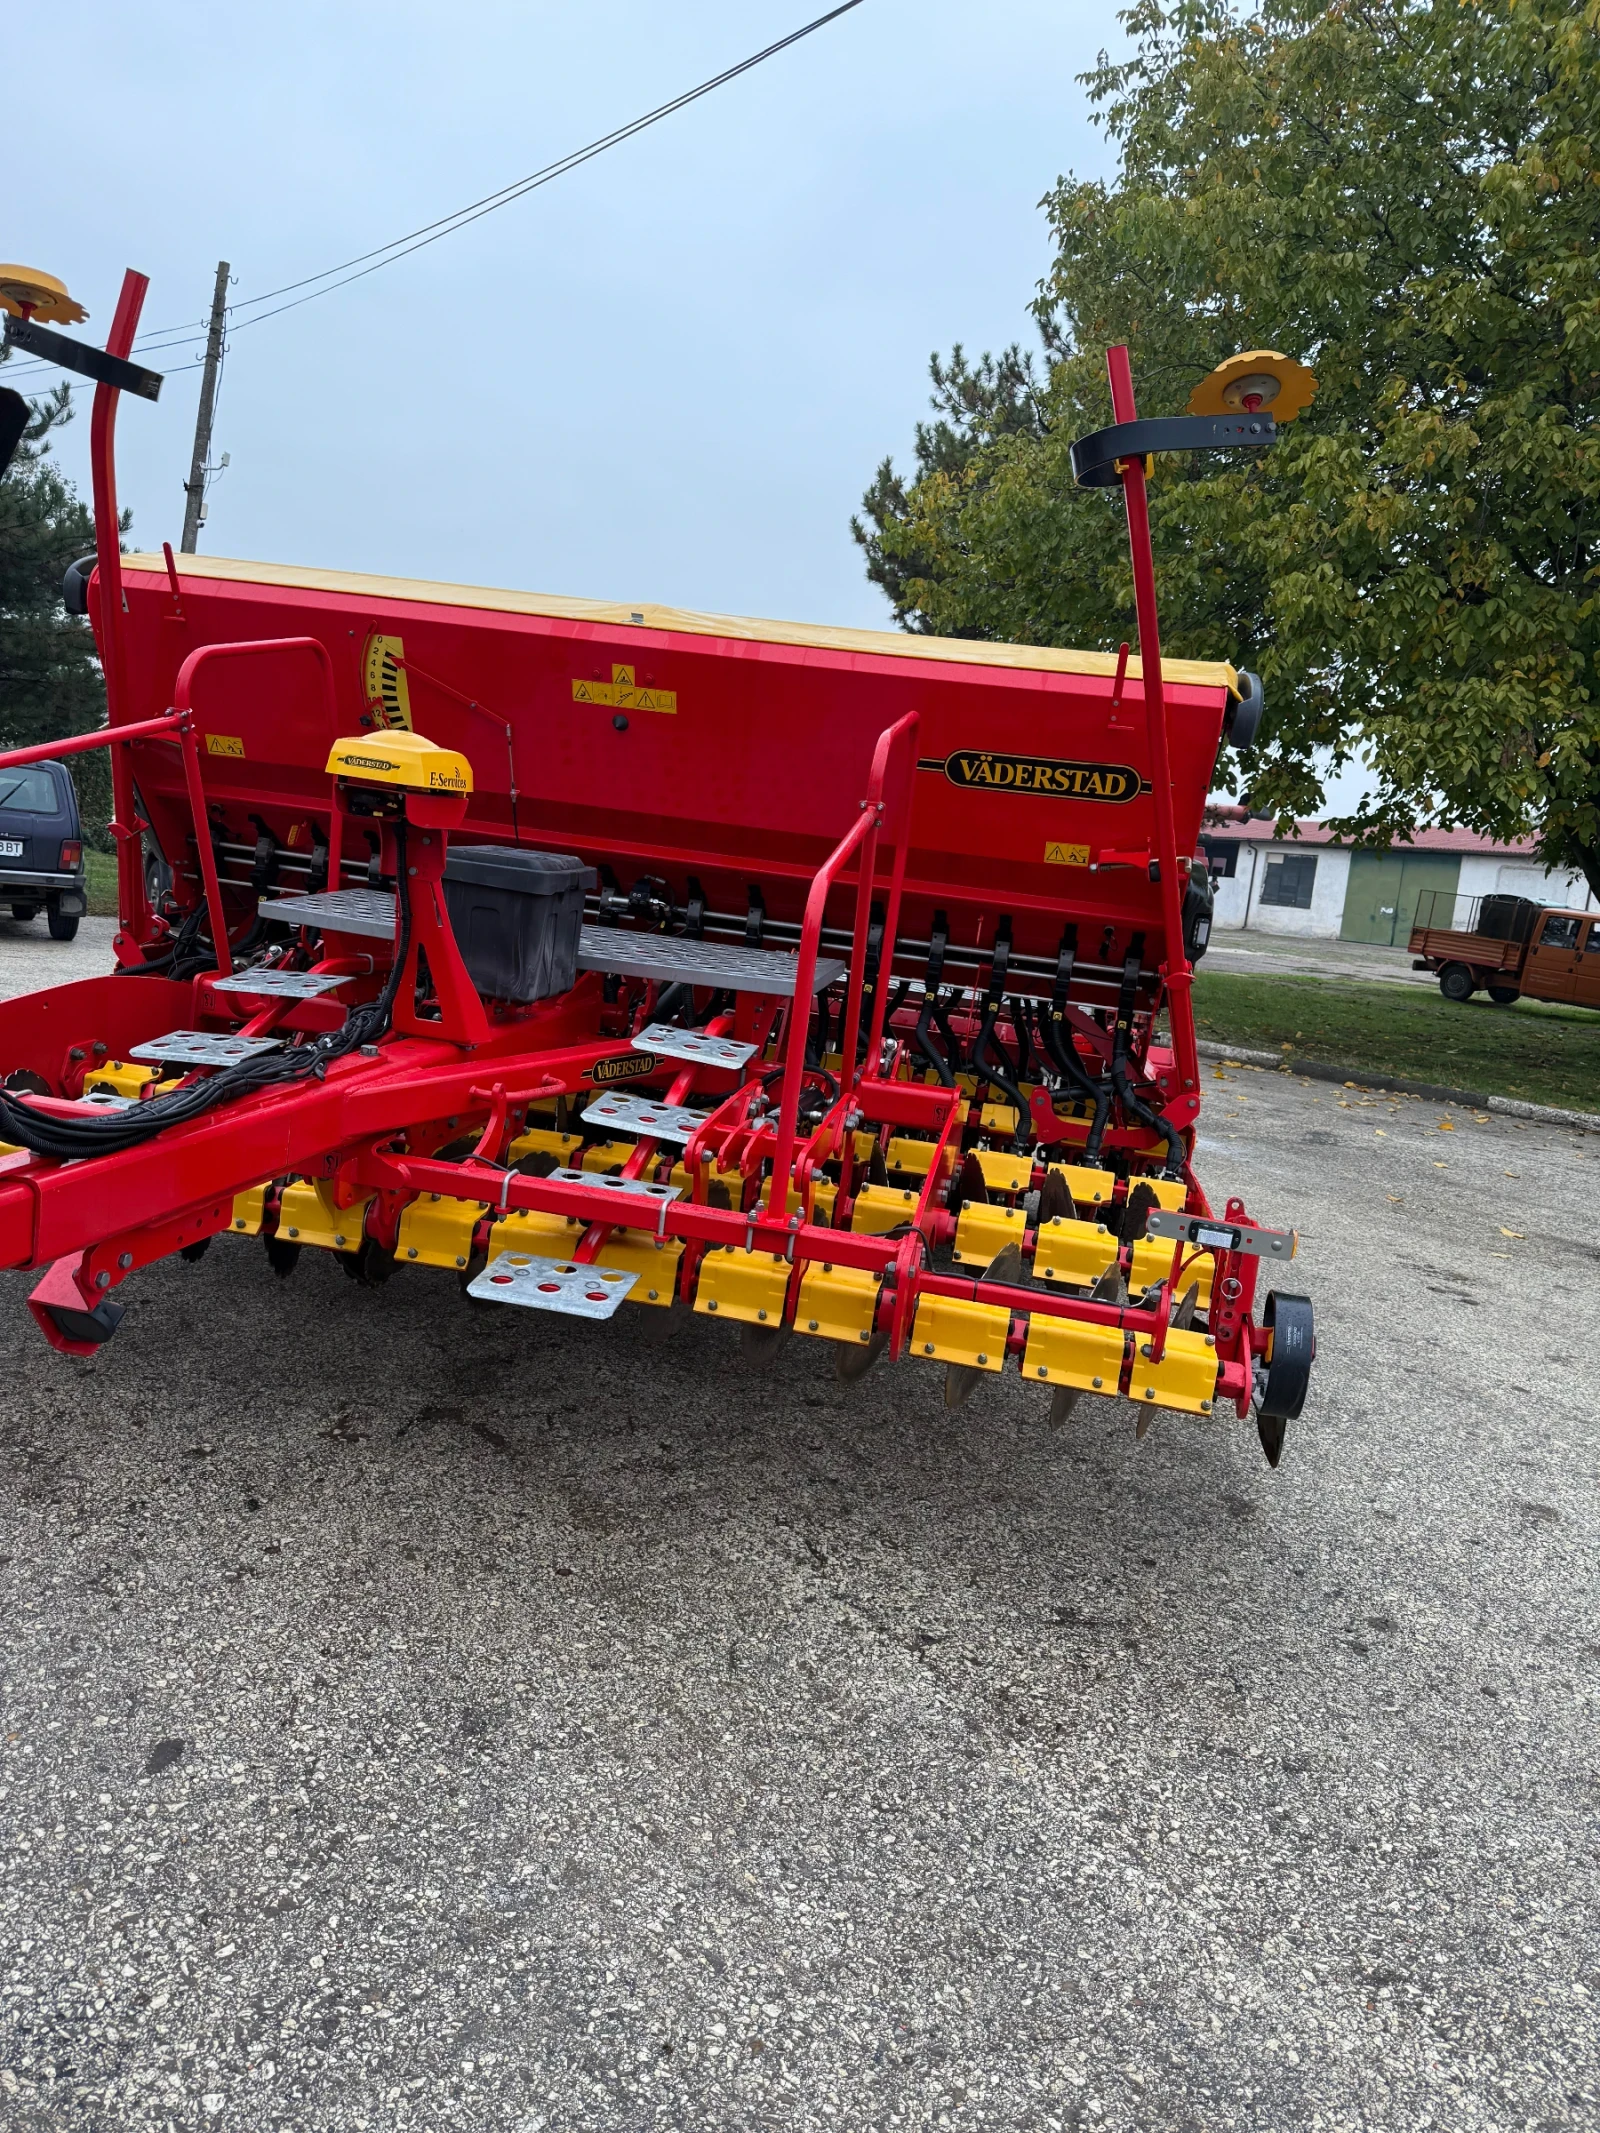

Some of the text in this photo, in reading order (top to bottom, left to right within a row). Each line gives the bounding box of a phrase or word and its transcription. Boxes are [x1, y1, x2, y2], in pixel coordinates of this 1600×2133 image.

[377, 635, 383, 643] 0
[372, 646, 379, 655] 2
[371, 658, 376, 667] 4
[370, 671, 375, 679] 6
[370, 684, 376, 692] 8
[372, 709, 382, 718] 12
[960, 755, 1127, 797] VÄDERSTAD
[597, 1057, 653, 1080] VÄDERSTAD
